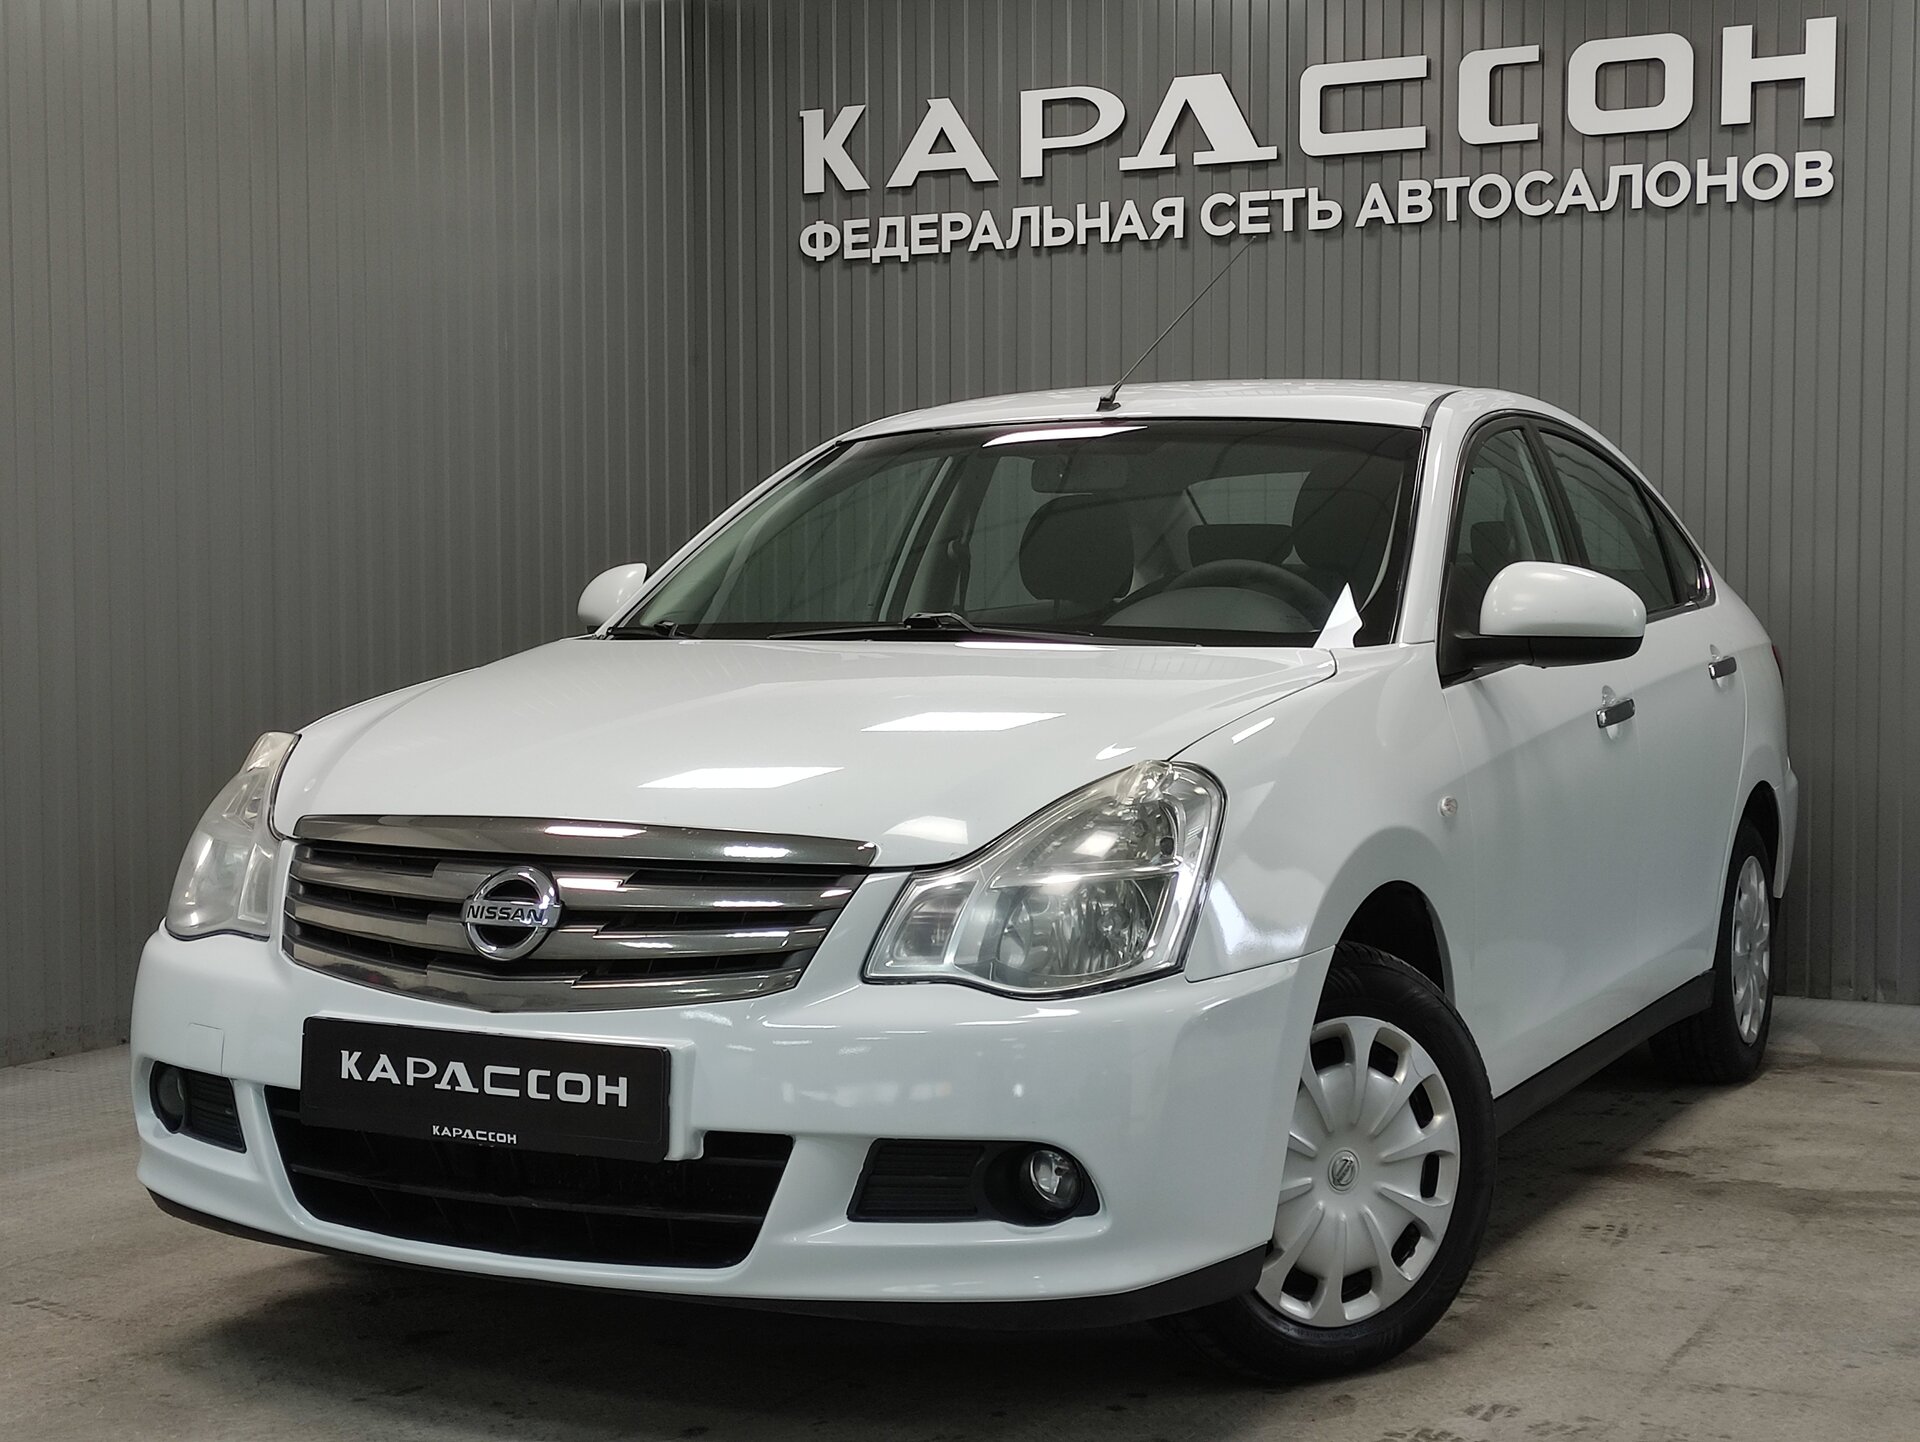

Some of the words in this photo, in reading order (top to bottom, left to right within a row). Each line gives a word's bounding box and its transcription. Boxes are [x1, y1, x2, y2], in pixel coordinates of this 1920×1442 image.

[799, 196, 1185, 264] ФЕДЕРАЛЬНАЯ
[1200, 187, 1343, 237] СЕТЬ
[1355, 150, 1835, 228] АВТОСАЛОНОВ
[466, 904, 545, 923] NISSAN
